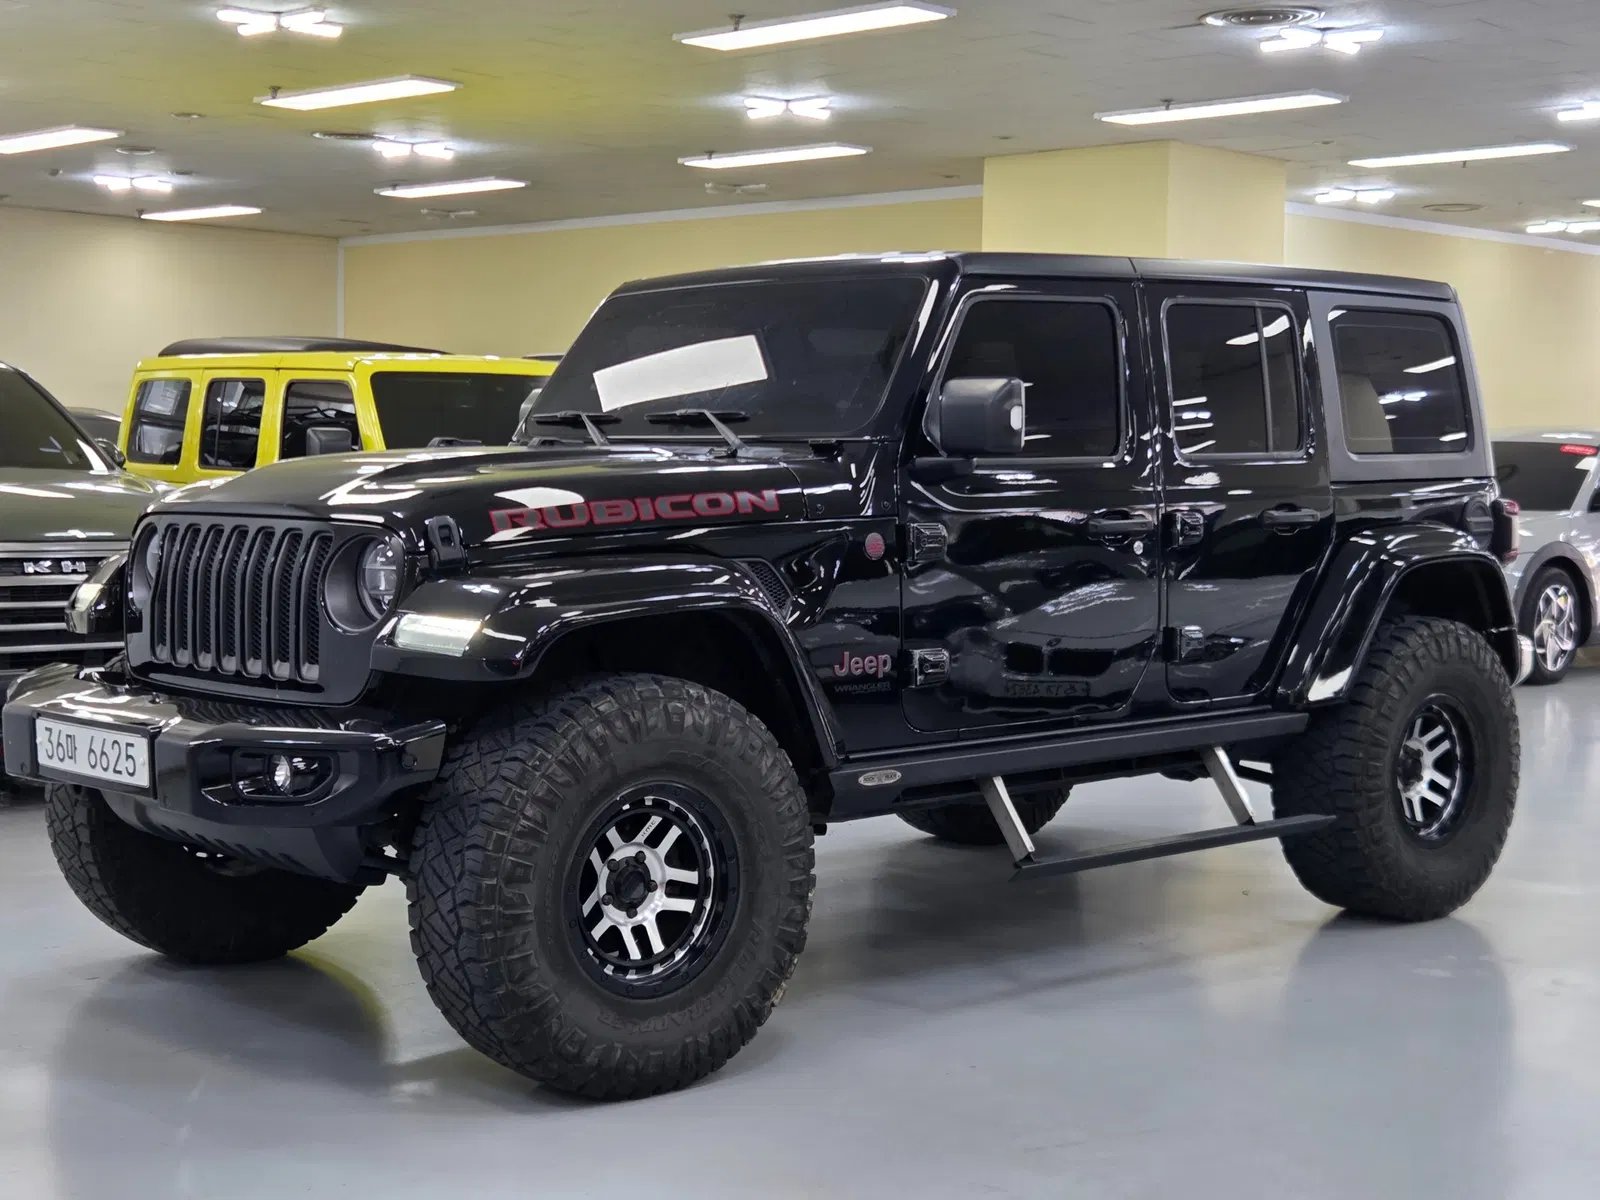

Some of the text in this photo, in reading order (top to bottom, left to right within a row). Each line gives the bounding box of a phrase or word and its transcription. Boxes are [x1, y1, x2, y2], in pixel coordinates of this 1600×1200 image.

[488, 488, 780, 533] RUBICON
[833, 651, 892, 679] Jeep
[44, 726, 136, 777] 36마 6625
